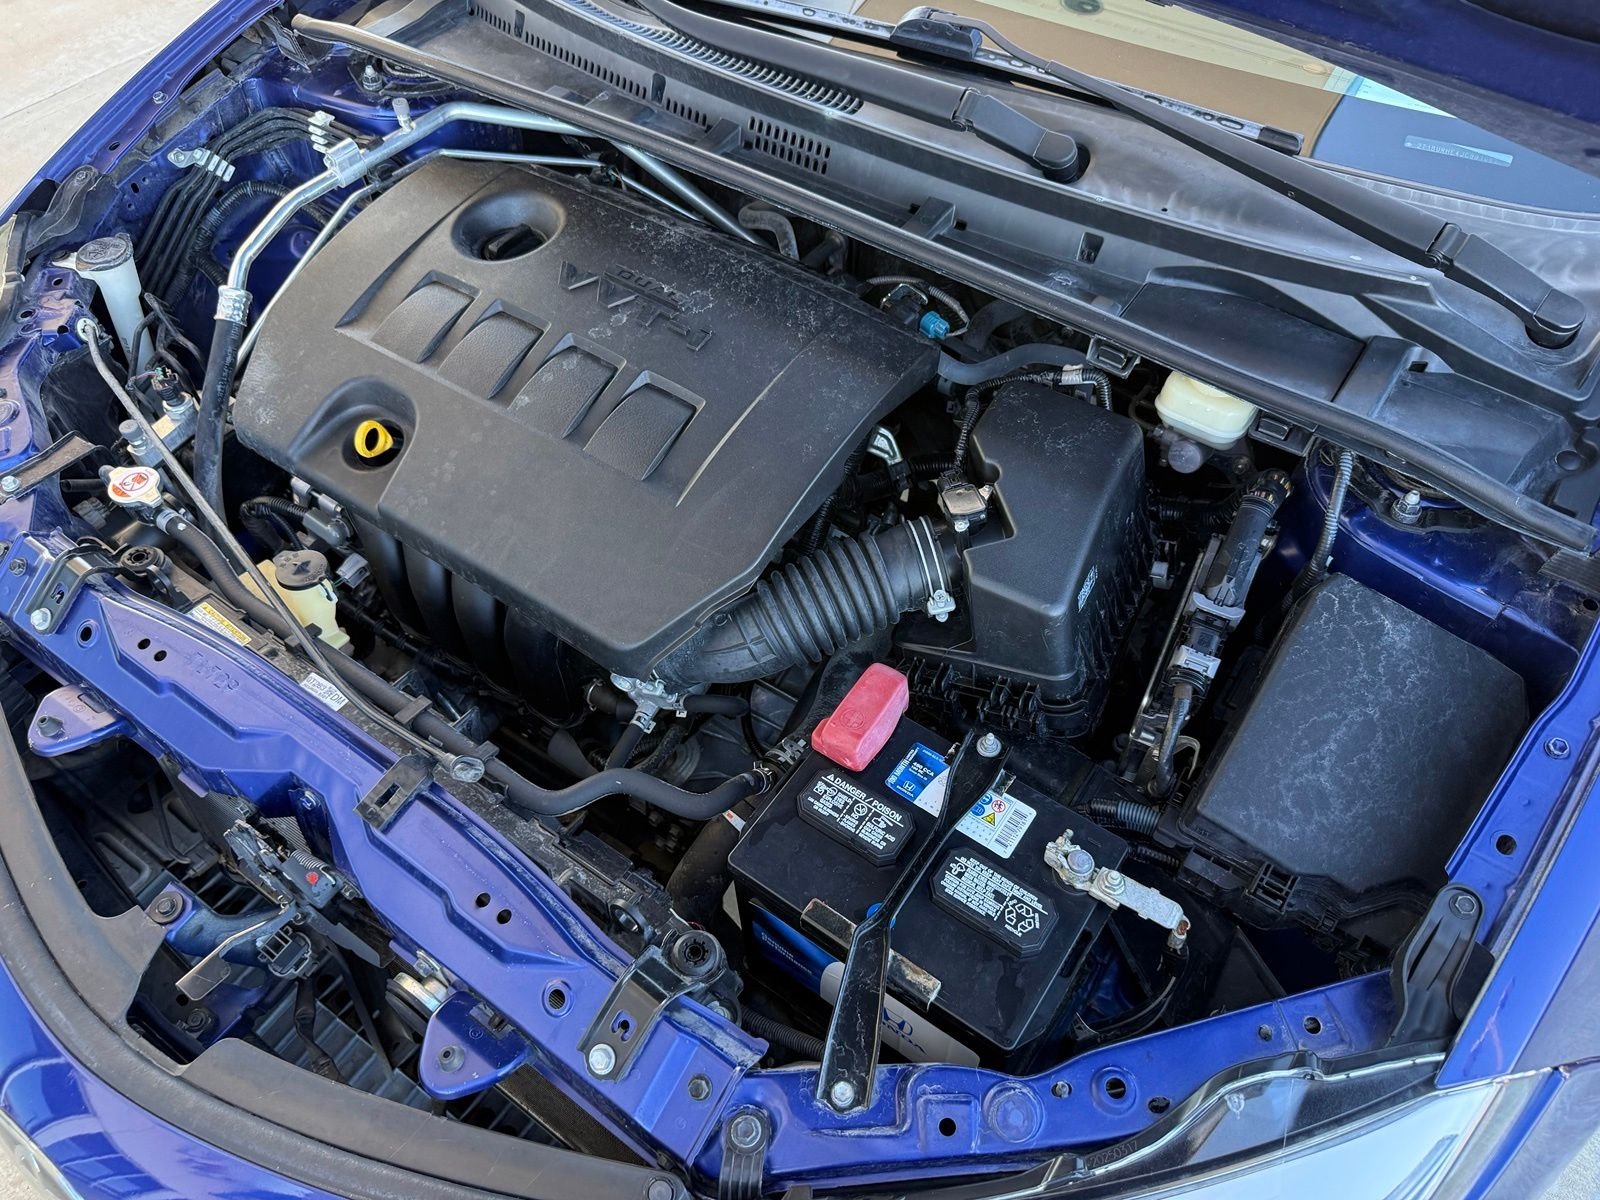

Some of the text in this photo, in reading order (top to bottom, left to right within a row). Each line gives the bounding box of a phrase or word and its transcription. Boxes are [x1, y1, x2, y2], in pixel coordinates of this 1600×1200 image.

[897, 759, 910, 777] MONTH
[922, 767, 935, 777] CCA
[836, 792, 852, 803] SHIELD
[896, 785, 914, 798] HONDA
[819, 798, 833, 809] GASES
[822, 794, 844, 809] EXPLOSIVE
[834, 777, 902, 822] DANGER / POISON
[850, 812, 859, 820] NO
[860, 829, 881, 843] BLINDNESS
[863, 825, 884, 840] CAN CAUSE
[865, 821, 896, 842] SULFURIC ACID
[969, 857, 980, 866] KEEP
[979, 863, 988, 871] OUT
[993, 872, 1002, 880] THE
[1000, 876, 1014, 887] REACH
[961, 875, 977, 888] MEDICAL
[975, 884, 987, 894] HELP
[966, 860, 975, 868] NOT
[991, 875, 1002, 884] VENT
[1022, 895, 1032, 903] AND
[985, 885, 994, 893] GET
